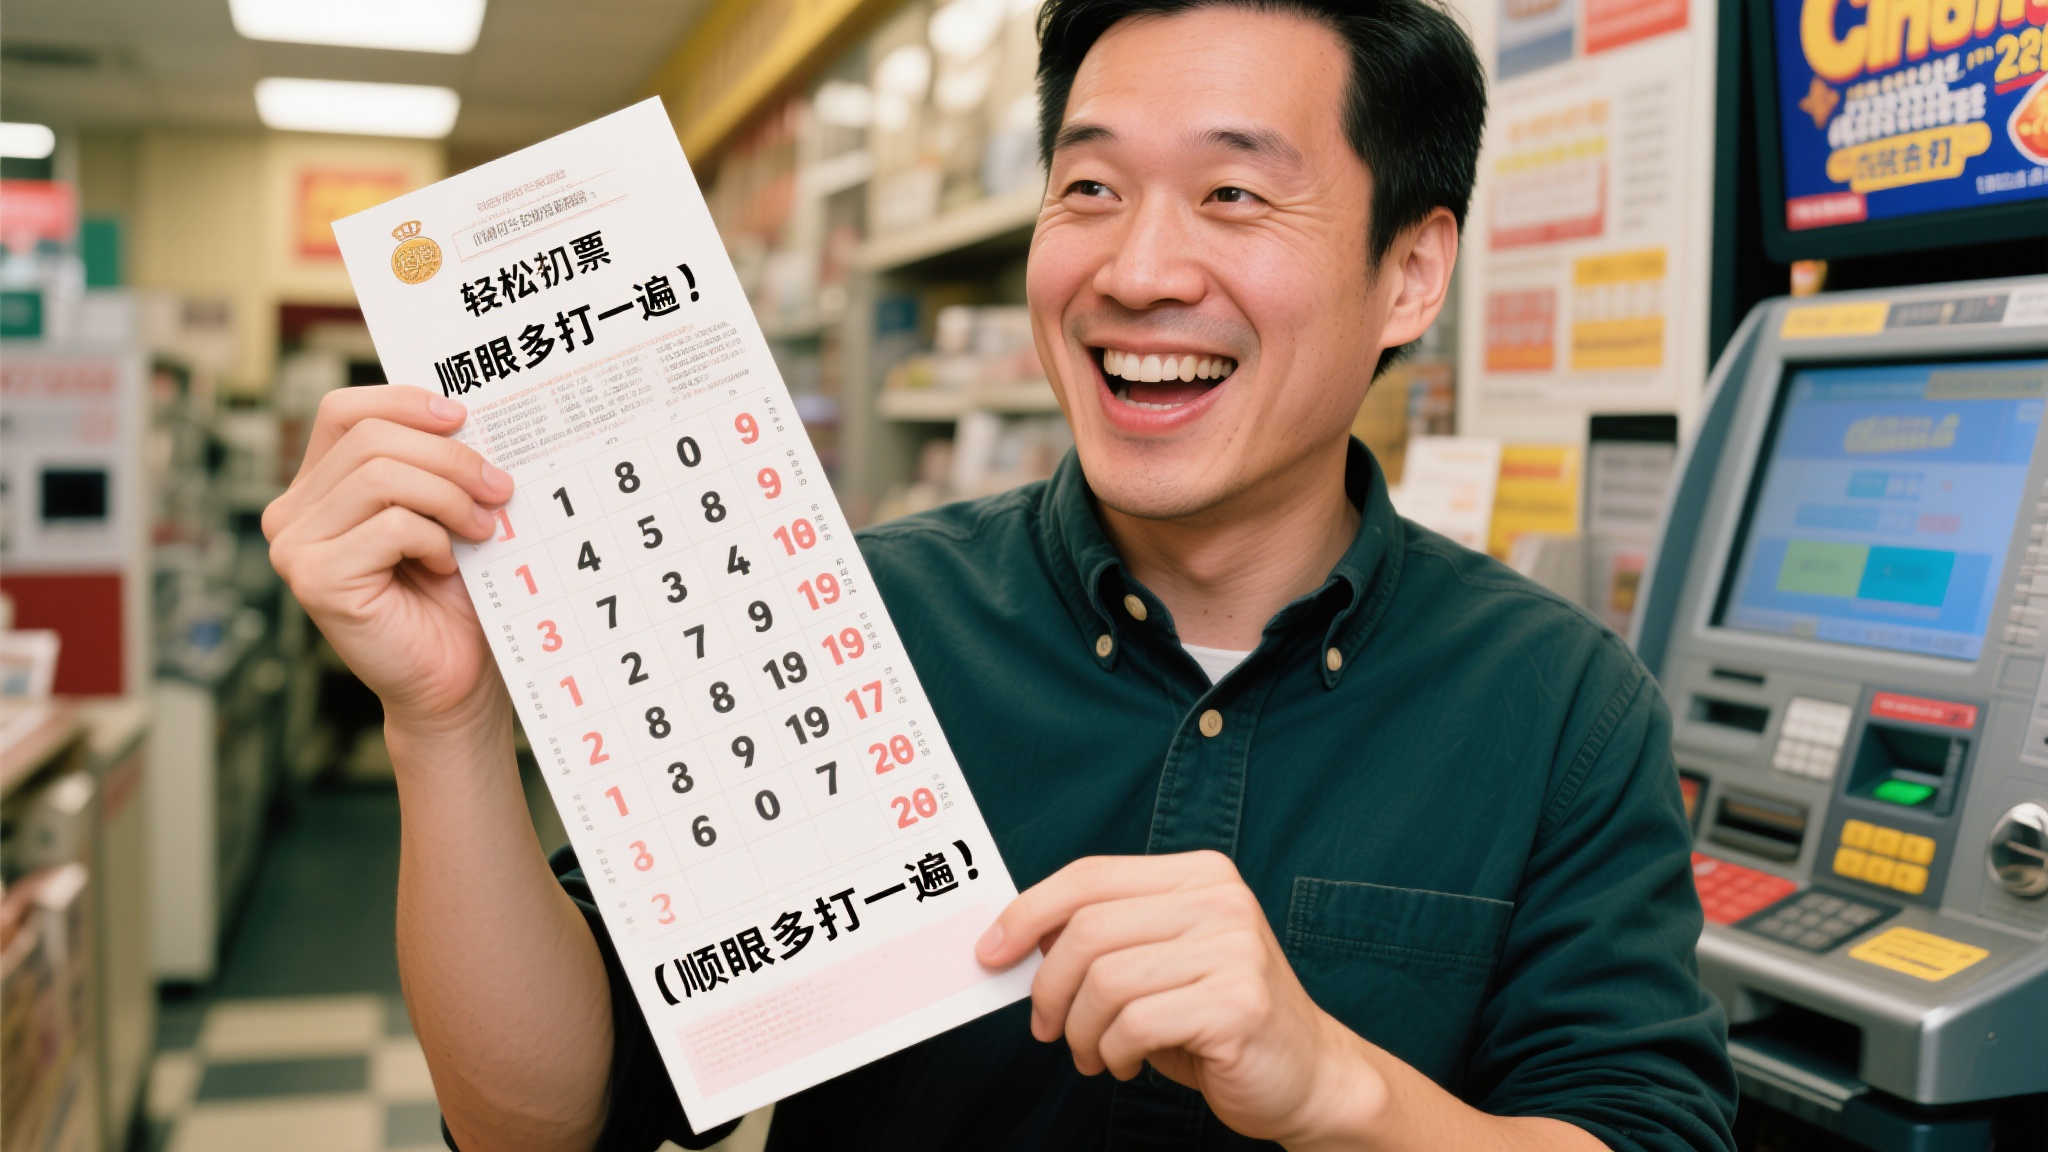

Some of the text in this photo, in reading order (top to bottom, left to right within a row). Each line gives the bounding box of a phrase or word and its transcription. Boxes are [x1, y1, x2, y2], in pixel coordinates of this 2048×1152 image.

[434, 263, 700, 398] 顺眼多打一遍！
[552, 486, 576, 517] 1
[614, 461, 641, 494] 8
[676, 436, 702, 468] 0
[733, 412, 760, 445] 9
[514, 564, 539, 596] 1
[577, 540, 602, 572] 4
[637, 515, 663, 549] 5
[701, 491, 727, 523] 8
[756, 466, 783, 500] 9
[536, 619, 564, 653] 3
[596, 595, 618, 629] 7
[662, 571, 688, 604] 3
[727, 545, 751, 576] 4
[559, 675, 584, 708] 1
[621, 651, 649, 686] 2
[683, 624, 706, 659] 7
[747, 600, 773, 633] 9
[797, 572, 841, 611] 19
[582, 730, 611, 766] 2
[645, 706, 671, 740] 8
[709, 681, 735, 714] 8
[763, 650, 808, 690] 19
[821, 627, 865, 667] 19
[604, 785, 630, 817] 1
[731, 735, 755, 768] 9
[785, 706, 830, 745] 19
[844, 679, 884, 721] 17
[692, 815, 717, 847] 6
[754, 790, 781, 821] 0
[815, 761, 838, 796] 7
[651, 892, 676, 925] 3
